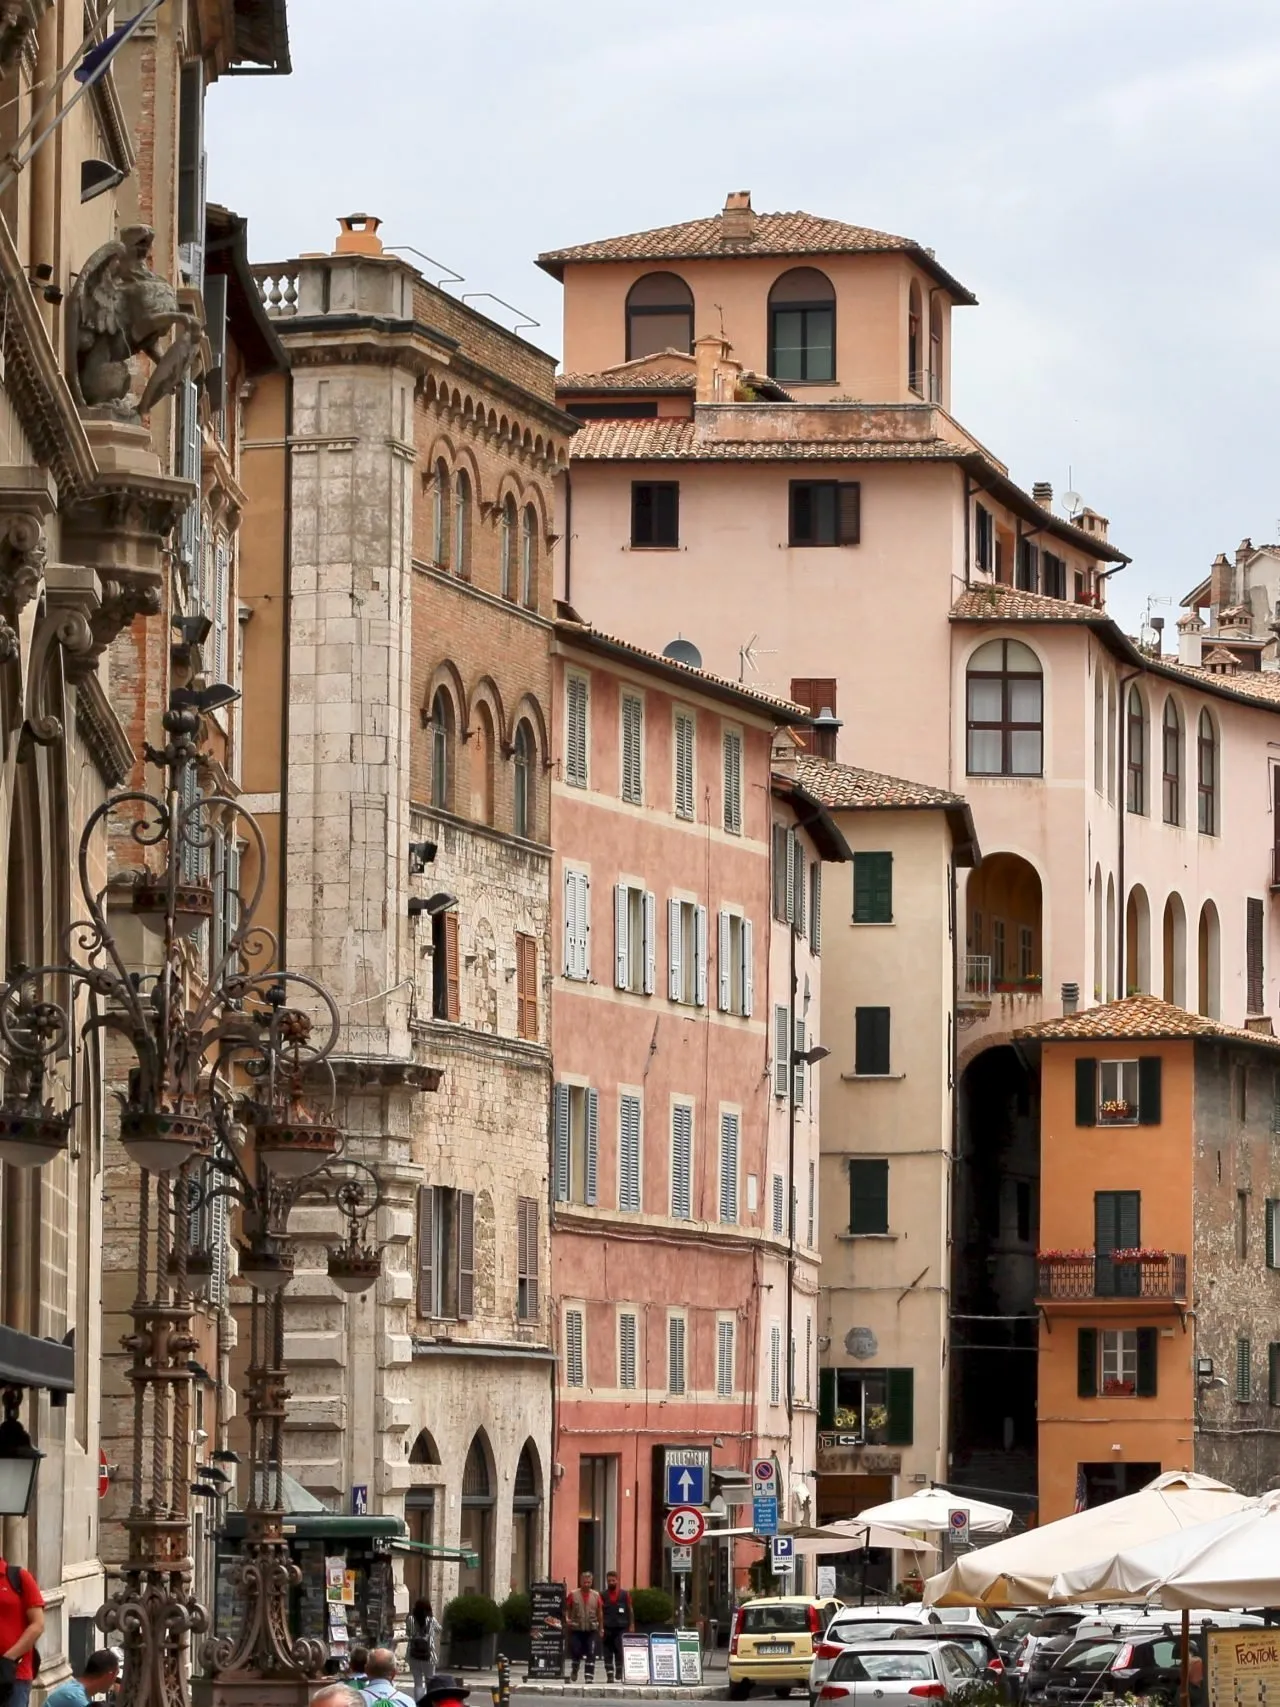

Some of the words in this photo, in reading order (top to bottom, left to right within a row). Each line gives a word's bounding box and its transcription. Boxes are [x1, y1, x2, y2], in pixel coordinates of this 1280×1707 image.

[675, 1515, 685, 1535] 2
[777, 1539, 788, 1555] P
[1235, 1643, 1279, 1665] FRONTONE
